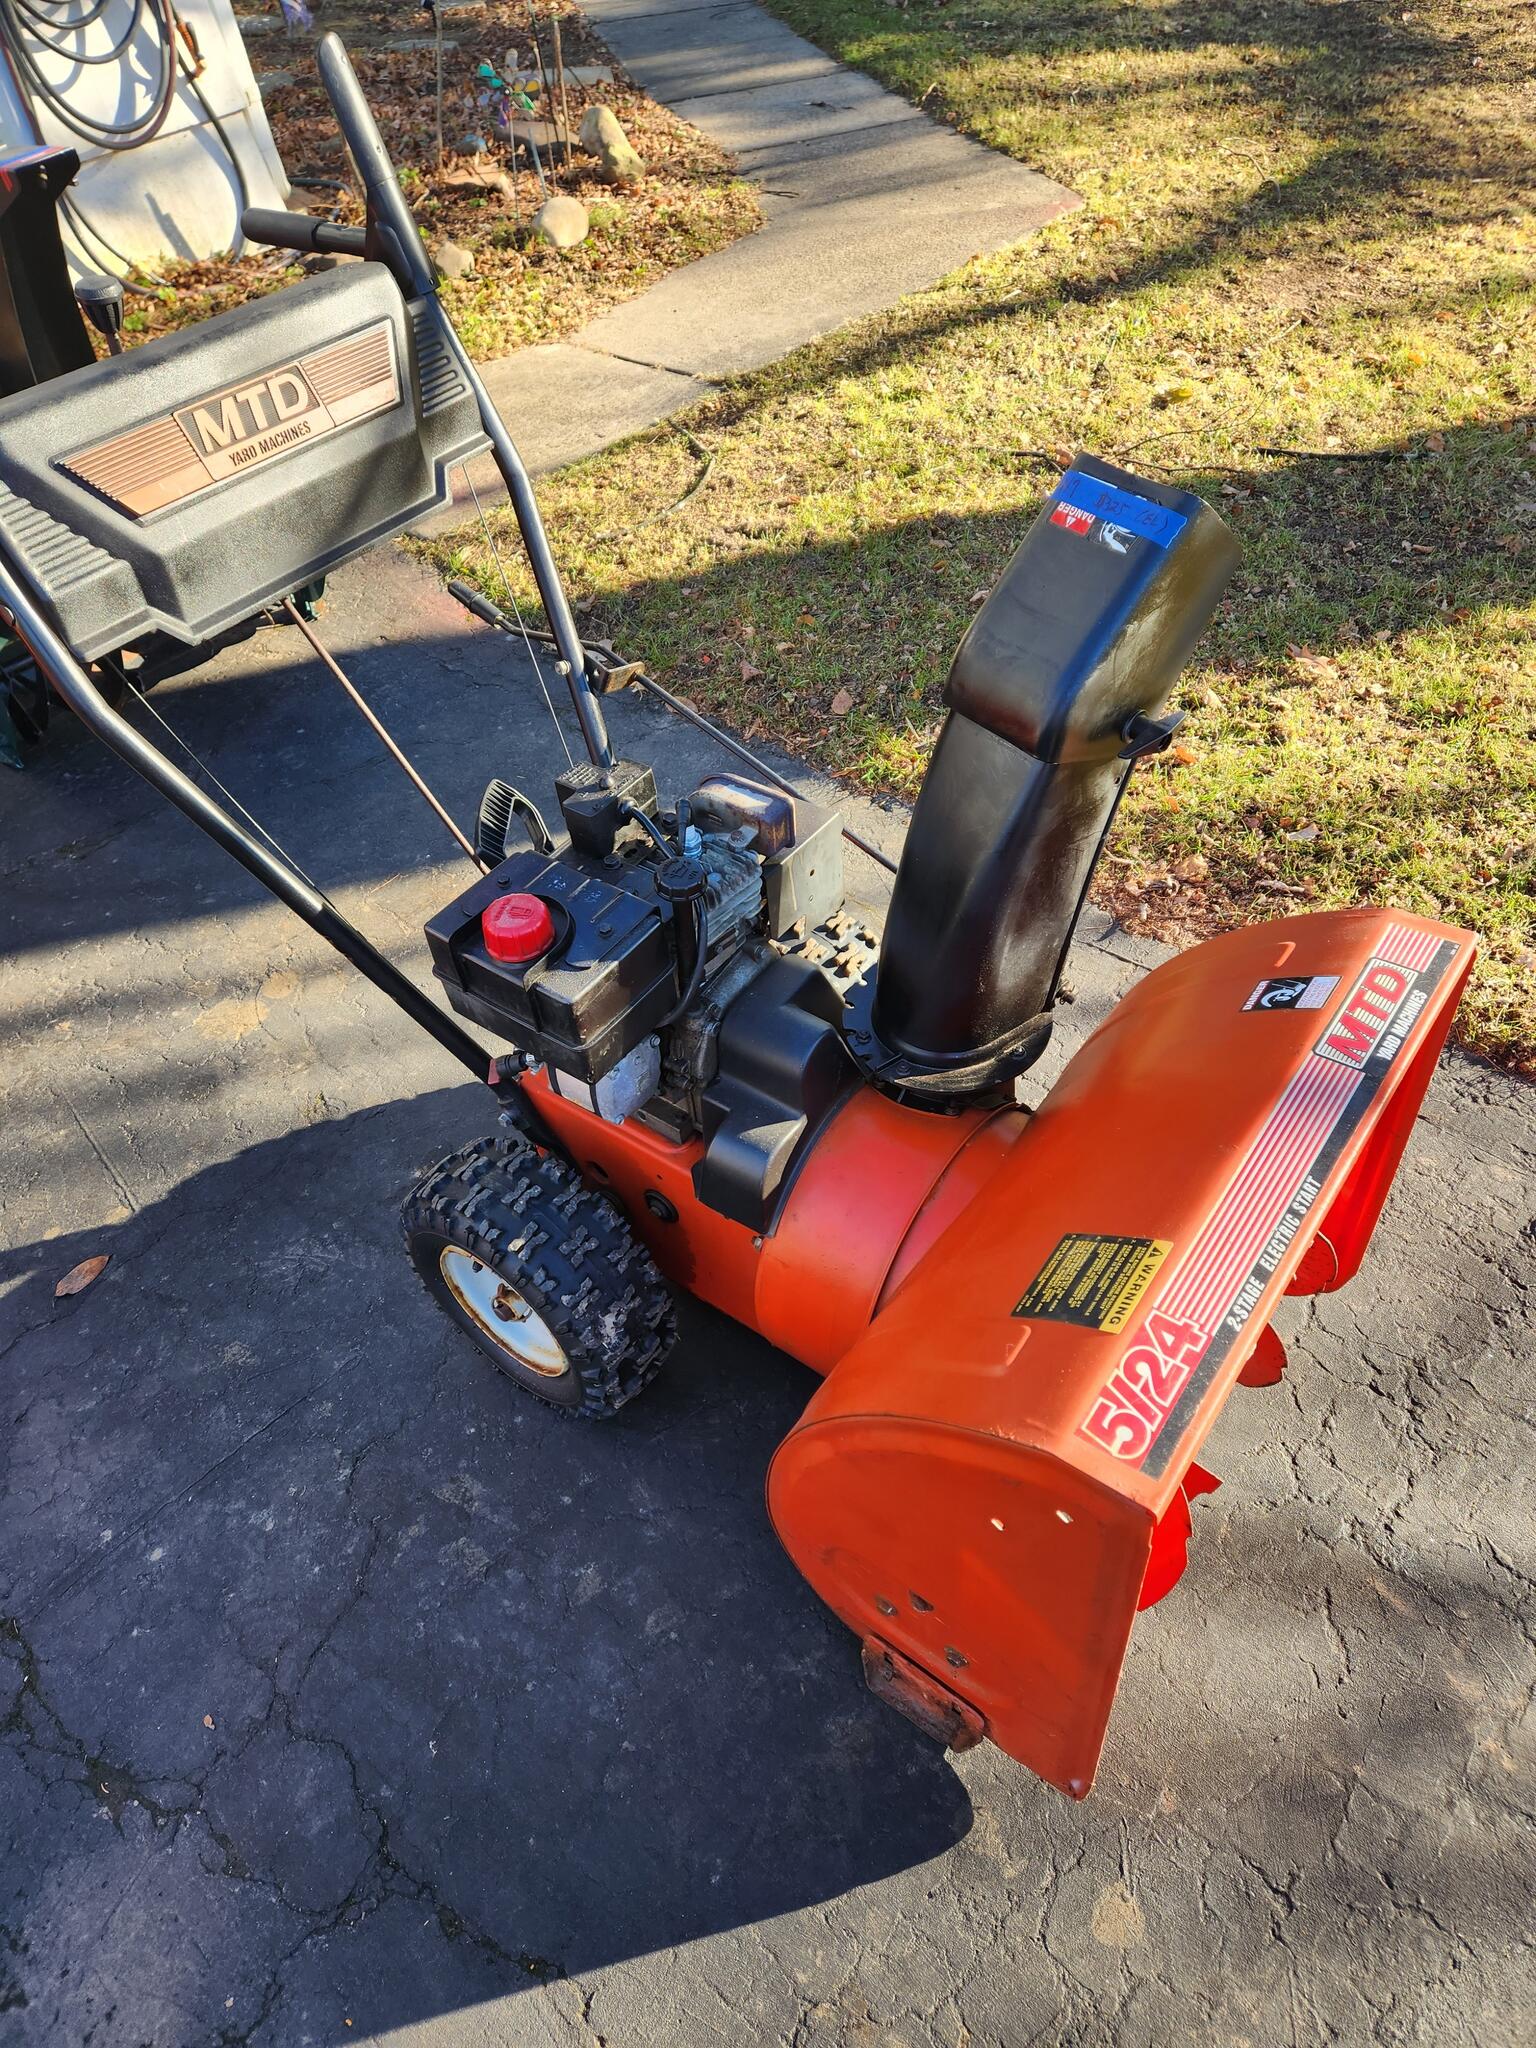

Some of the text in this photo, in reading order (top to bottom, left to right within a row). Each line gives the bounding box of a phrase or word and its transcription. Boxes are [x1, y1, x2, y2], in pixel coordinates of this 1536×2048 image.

[192, 373, 309, 453] MTD
[228, 420, 312, 467] YARD MACHINES
[1058, 501, 1096, 524] DANGER
[1241, 980, 1270, 1011] DANGER
[1325, 966, 1408, 1063] MTD
[1376, 989, 1428, 1061] YARD MACHINES
[1227, 1175, 1322, 1332] 2-STAGE ELECTRIC START
[1108, 1263, 1156, 1326] WARNING
[1081, 1309, 1208, 1460] 5/24
